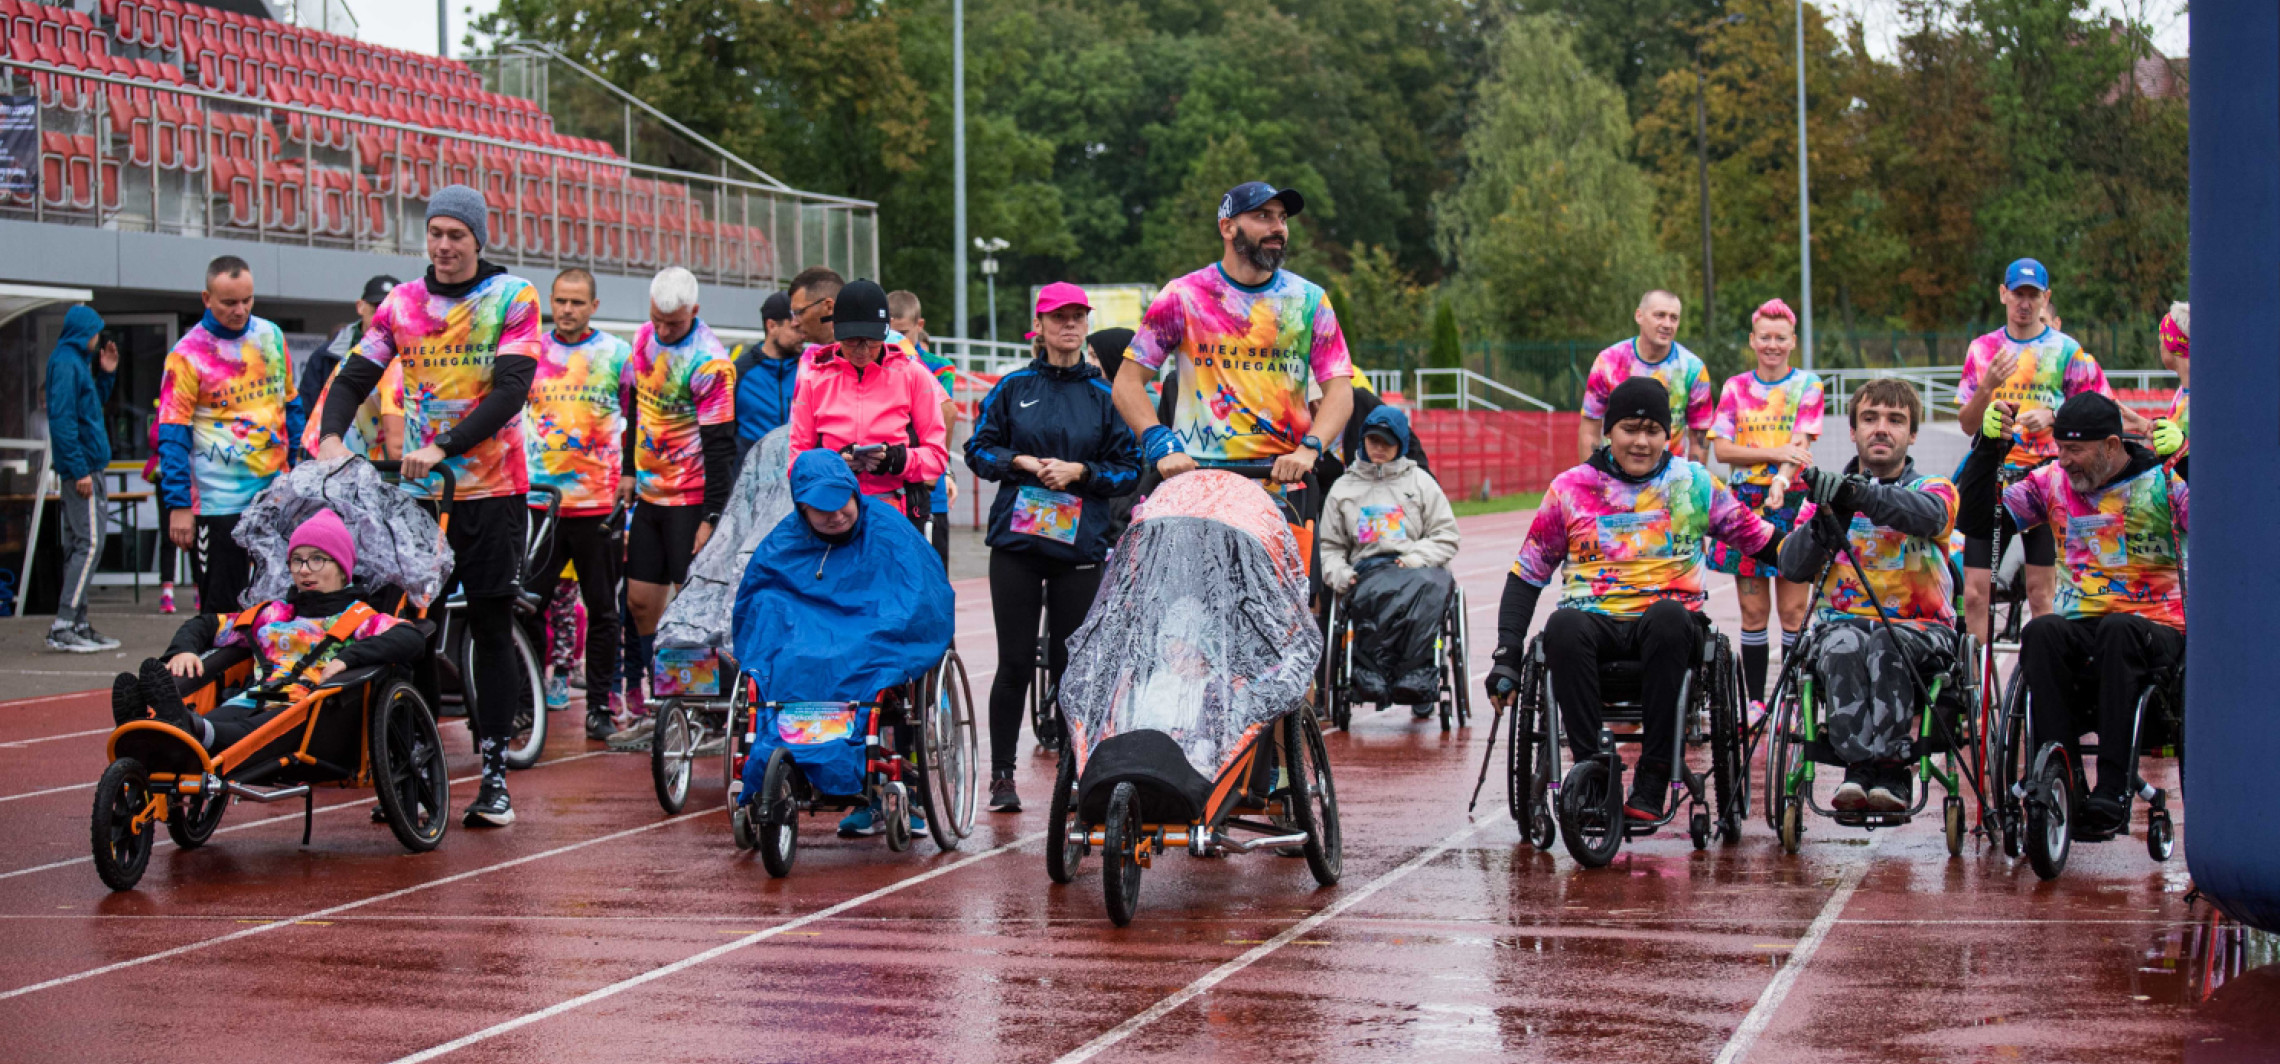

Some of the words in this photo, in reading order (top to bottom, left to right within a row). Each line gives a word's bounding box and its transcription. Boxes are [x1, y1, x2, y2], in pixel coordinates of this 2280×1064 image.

[403, 345, 436, 355] MIEJ
[444, 343, 495, 354] SERCE
[1197, 343, 1238, 355] MIEJ
[1248, 347, 1299, 360] SERCE
[1195, 357, 1213, 367] DO
[1223, 359, 1300, 374] BIEGANIA
[211, 399, 229, 409] DO
[1034, 508, 1058, 527] 14
[1630, 532, 1643, 547] 1
[2088, 538, 2101, 556] 6
[1863, 540, 1878, 557] 2
[278, 635, 291, 651] 6
[680, 670, 692, 684] 9
[807, 721, 822, 734] 4
